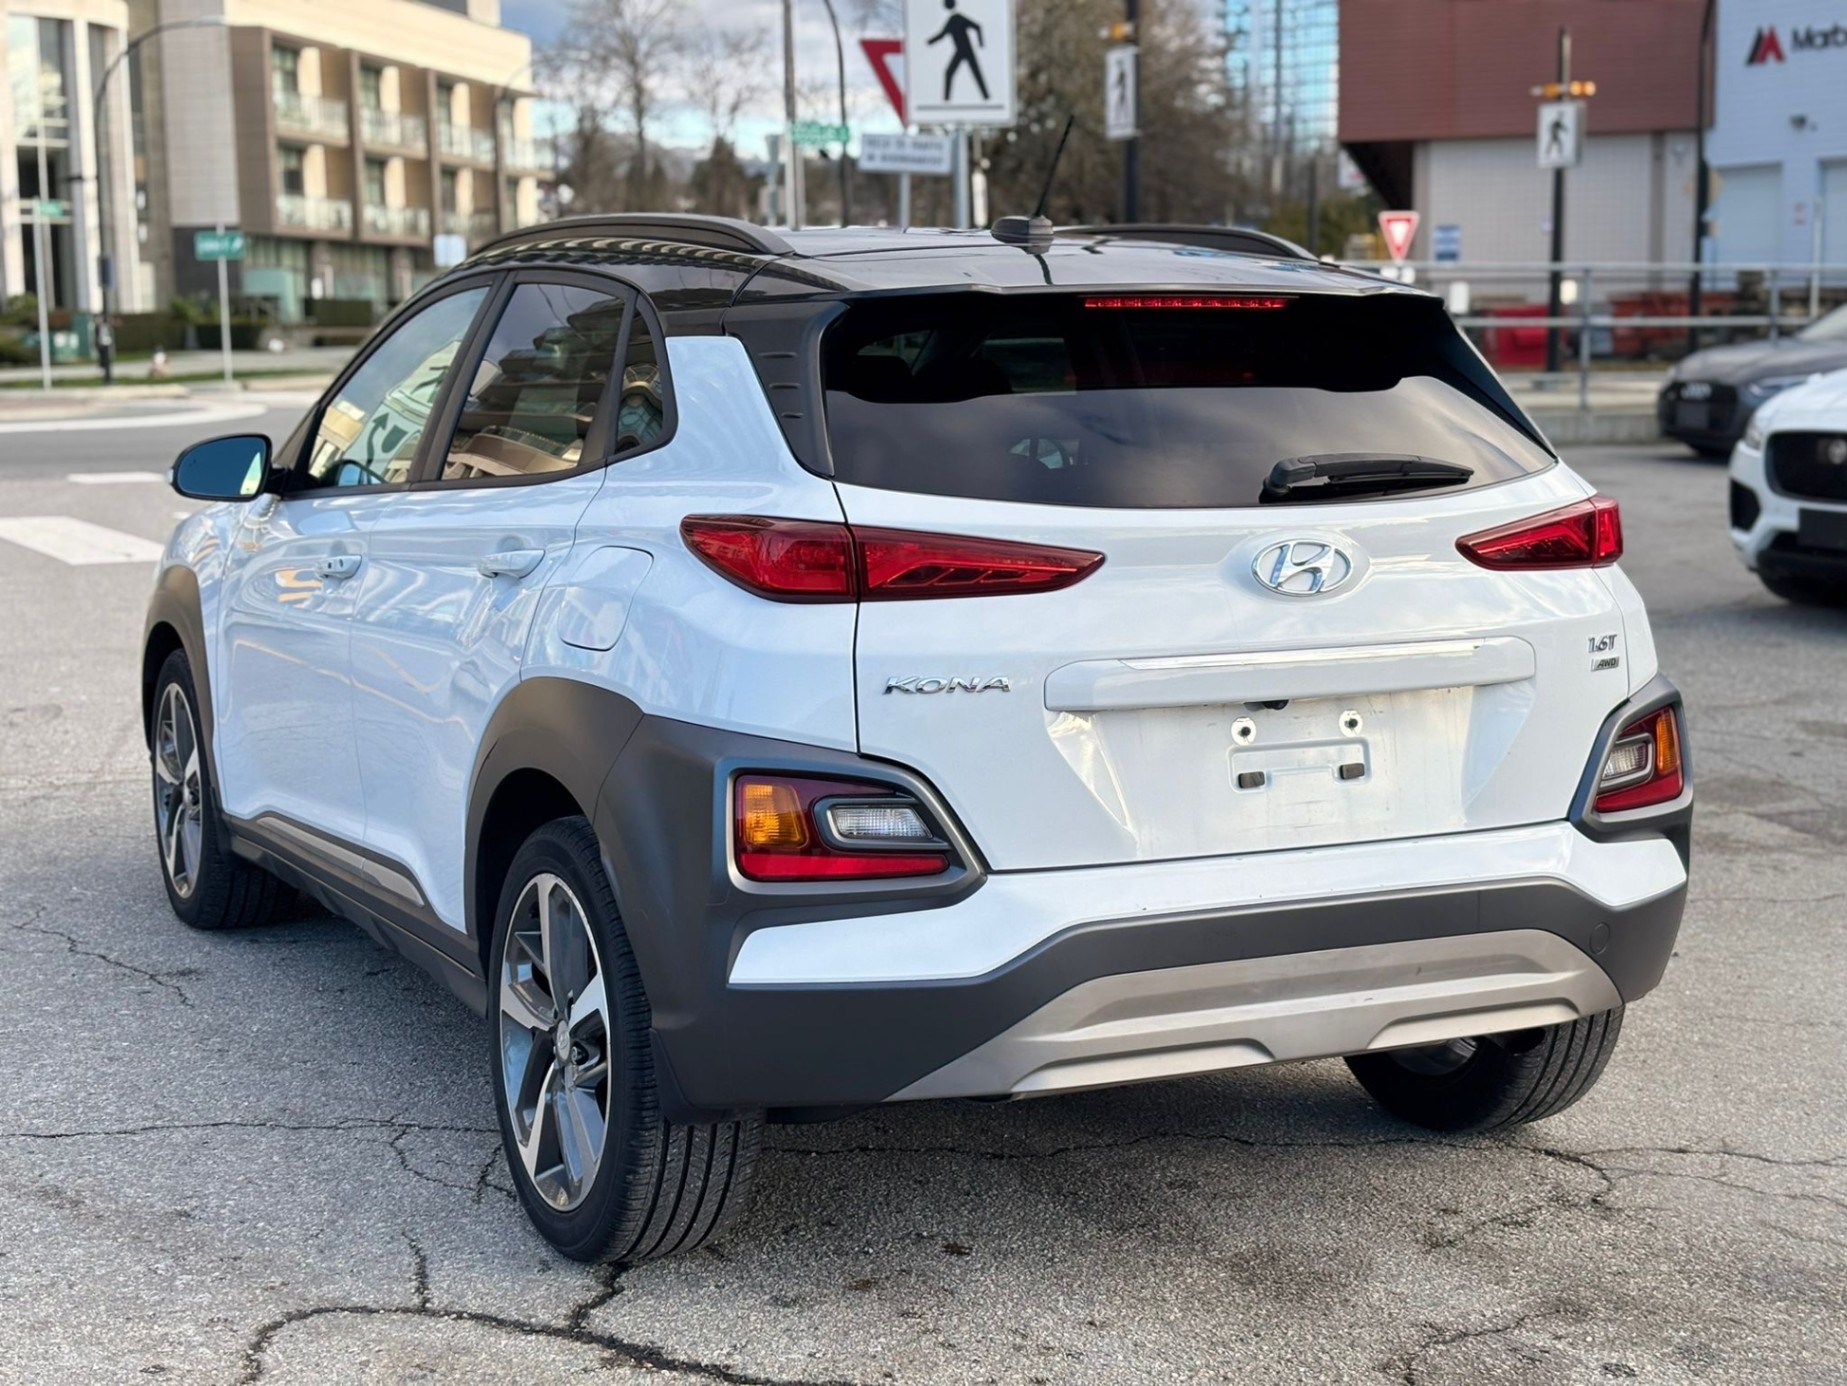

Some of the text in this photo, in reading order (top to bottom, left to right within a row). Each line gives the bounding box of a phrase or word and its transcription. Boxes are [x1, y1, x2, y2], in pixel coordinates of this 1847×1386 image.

[1588, 634, 1617, 653] 1.6T
[1596, 657, 1617, 669] AWD
[883, 675, 1011, 695] KONA
